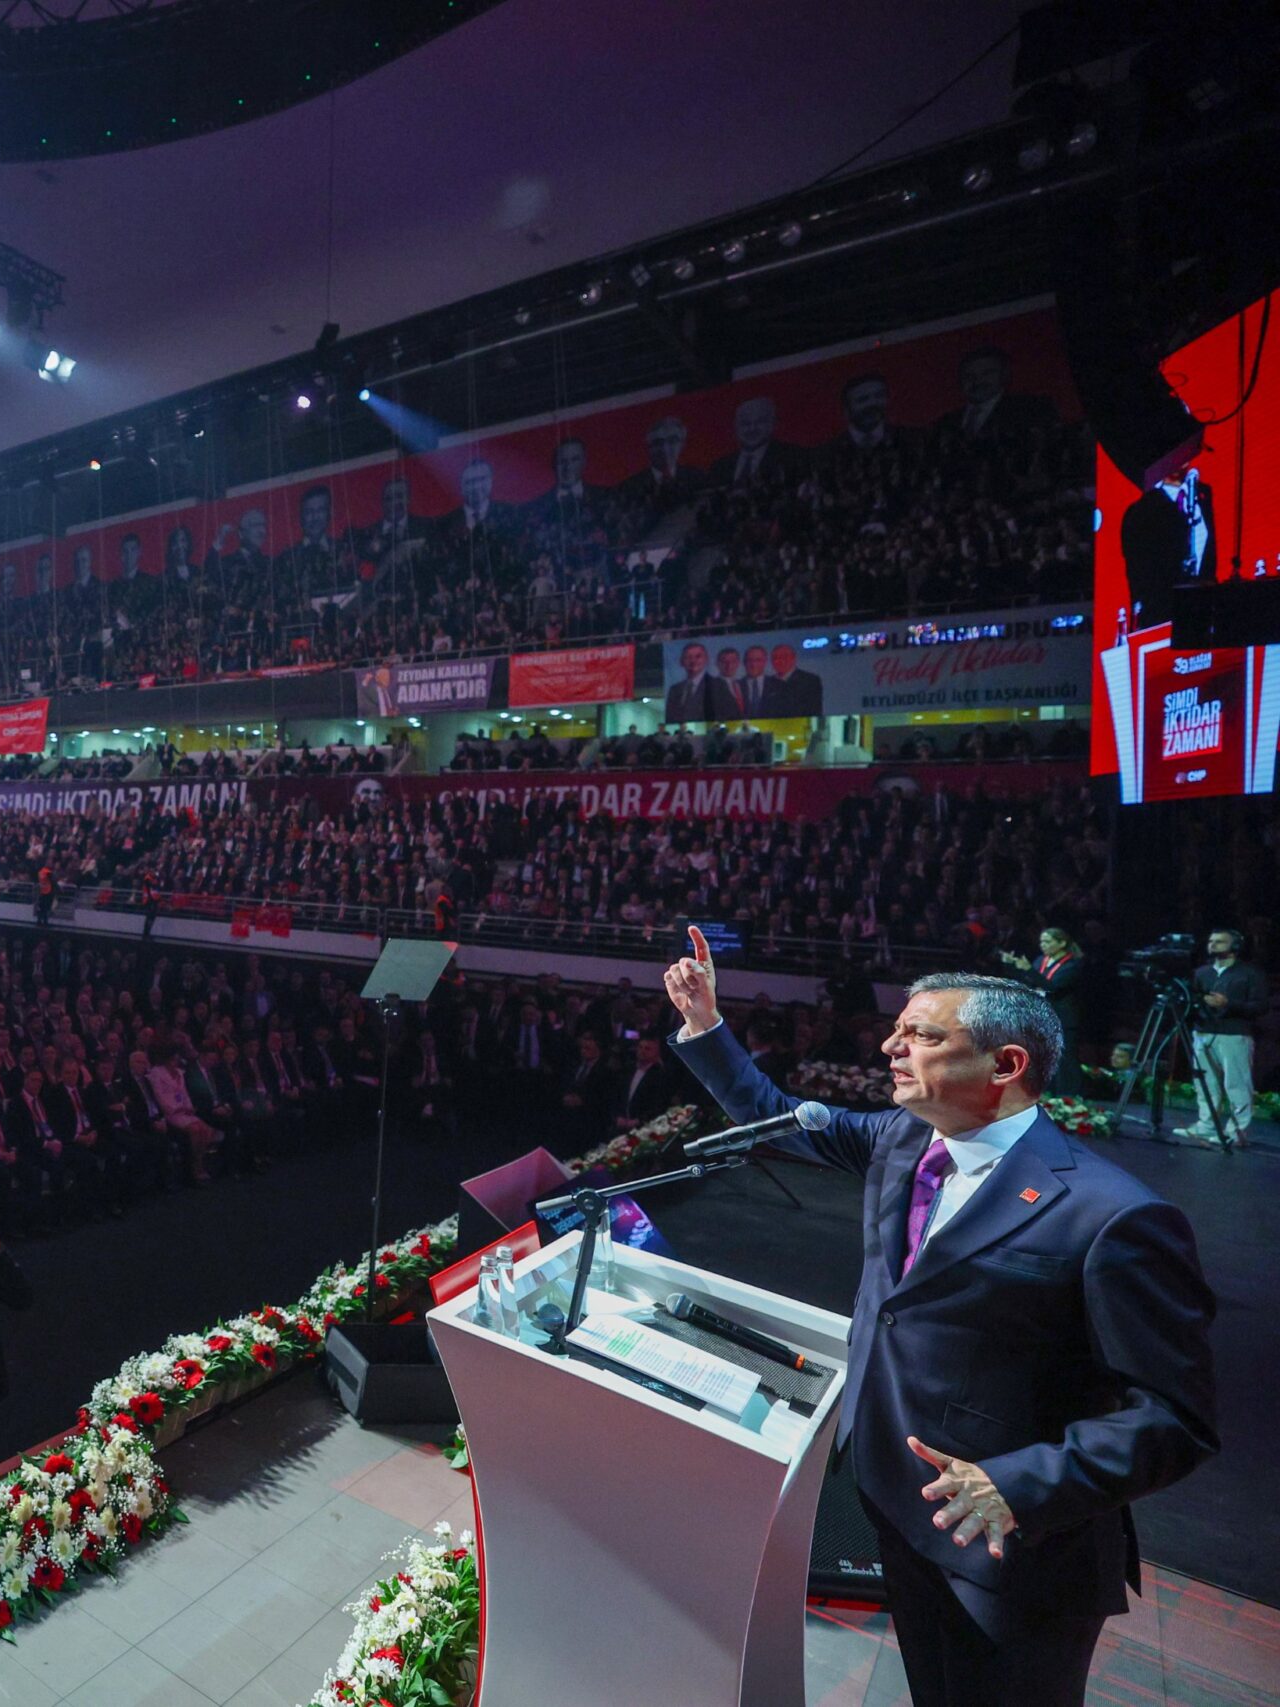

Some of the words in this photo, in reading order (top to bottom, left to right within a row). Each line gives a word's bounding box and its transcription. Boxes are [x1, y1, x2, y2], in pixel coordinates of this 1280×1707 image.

[397, 678, 487, 704] ADANA'DIR
[398, 668, 435, 682] ZEYDAN
[1163, 700, 1222, 735] İKTİDAR
[1162, 723, 1220, 758] ZAMANI
[648, 777, 788, 817] ZAMANI
